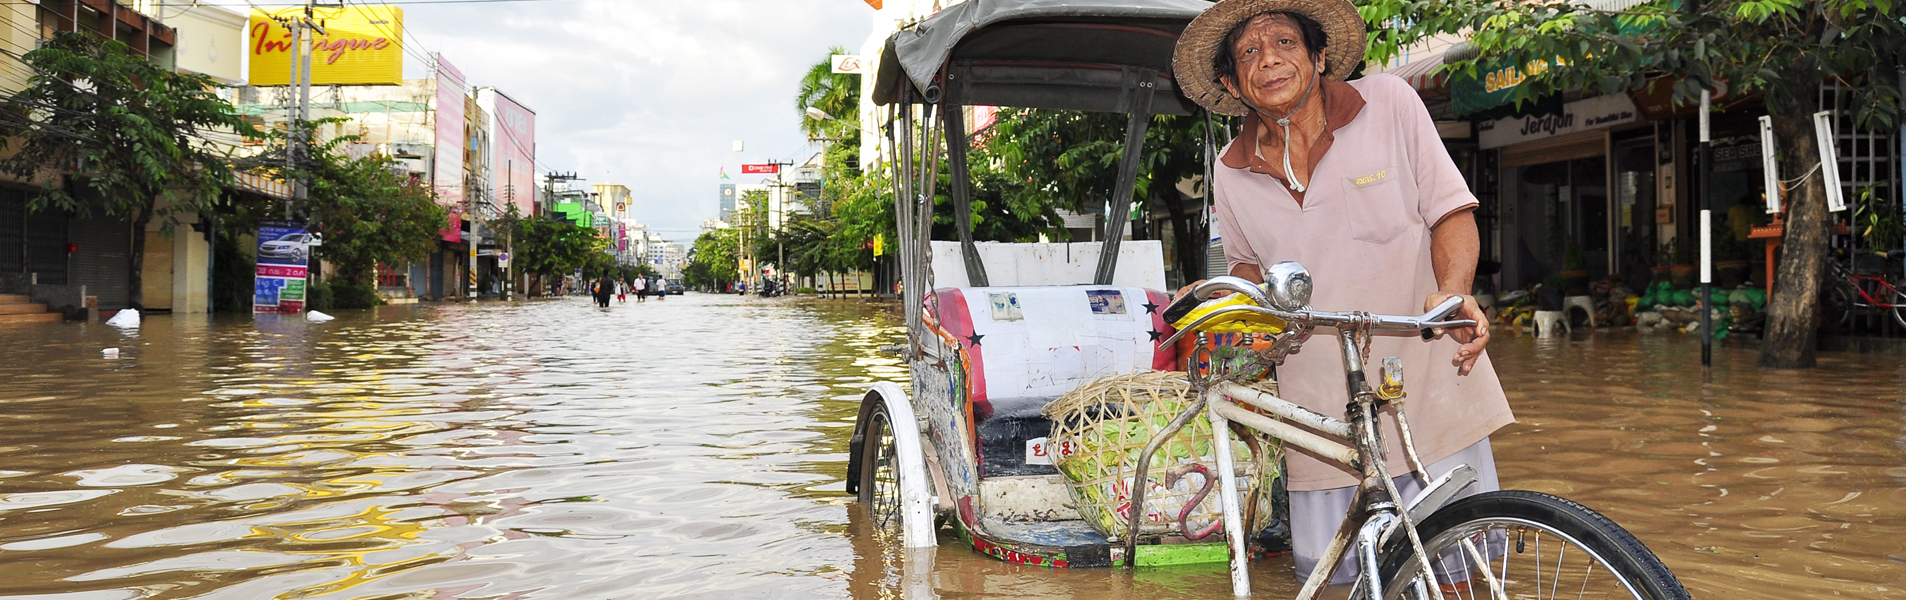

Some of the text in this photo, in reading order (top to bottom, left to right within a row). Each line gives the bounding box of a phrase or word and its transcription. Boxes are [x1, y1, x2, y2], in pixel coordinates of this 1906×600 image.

[252, 21, 390, 65] Inigue
[1716, 143, 1762, 161] SEA SHO
